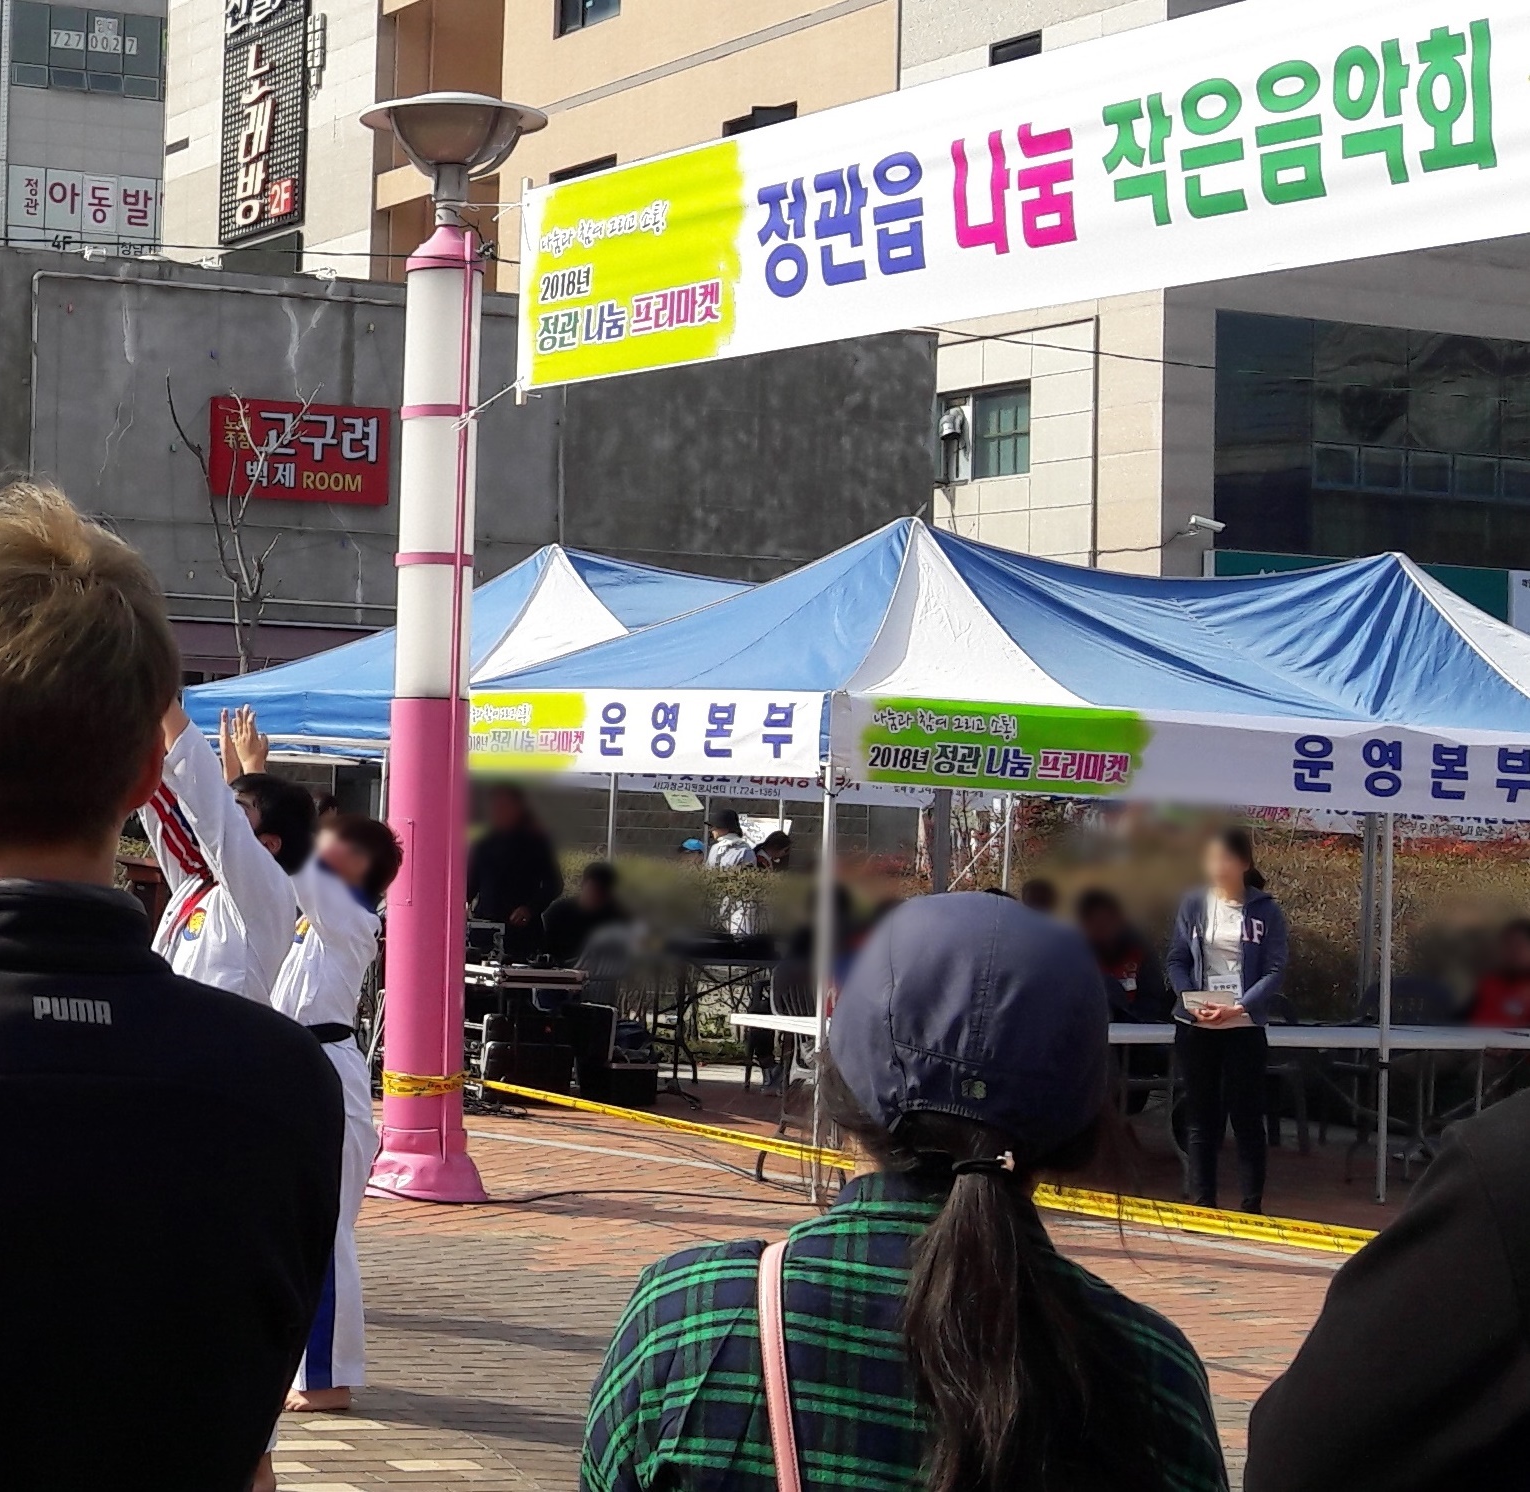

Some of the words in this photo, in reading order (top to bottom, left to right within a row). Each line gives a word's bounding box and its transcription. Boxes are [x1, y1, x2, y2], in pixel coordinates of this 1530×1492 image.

[53, 31, 82, 48] 727
[236, 44, 276, 226] 노래방
[757, 151, 926, 298] 정관읍
[952, 123, 1077, 255] 나눔
[1103, 18, 1497, 227] 작은음악회
[24, 178, 40, 216] 정관
[49, 182, 164, 227] 아동발
[270, 179, 293, 215] 2F
[51, 234, 72, 250] 4F
[578, 220, 603, 247] 참여
[610, 212, 635, 233] 그리고
[541, 266, 591, 302] 2018년
[538, 310, 581, 352] 정관
[584, 302, 625, 342] 나눔
[632, 282, 721, 333] 프리마켓
[260, 411, 378, 463] 고구려
[245, 460, 295, 488] 백제
[302, 471, 363, 493] ROOM
[538, 730, 585, 753] 프리마켓
[873, 707, 914, 733] 나눔과
[917, 708, 948, 734] 참여
[953, 715, 987, 733] 그리고
[991, 715, 1017, 740] 소통!
[868, 745, 931, 772] 2018년
[933, 743, 982, 776] 정관
[985, 746, 1033, 779] 나눔
[1037, 749, 1130, 784] 프리마켓
[32, 995, 113, 1025] PUMA
